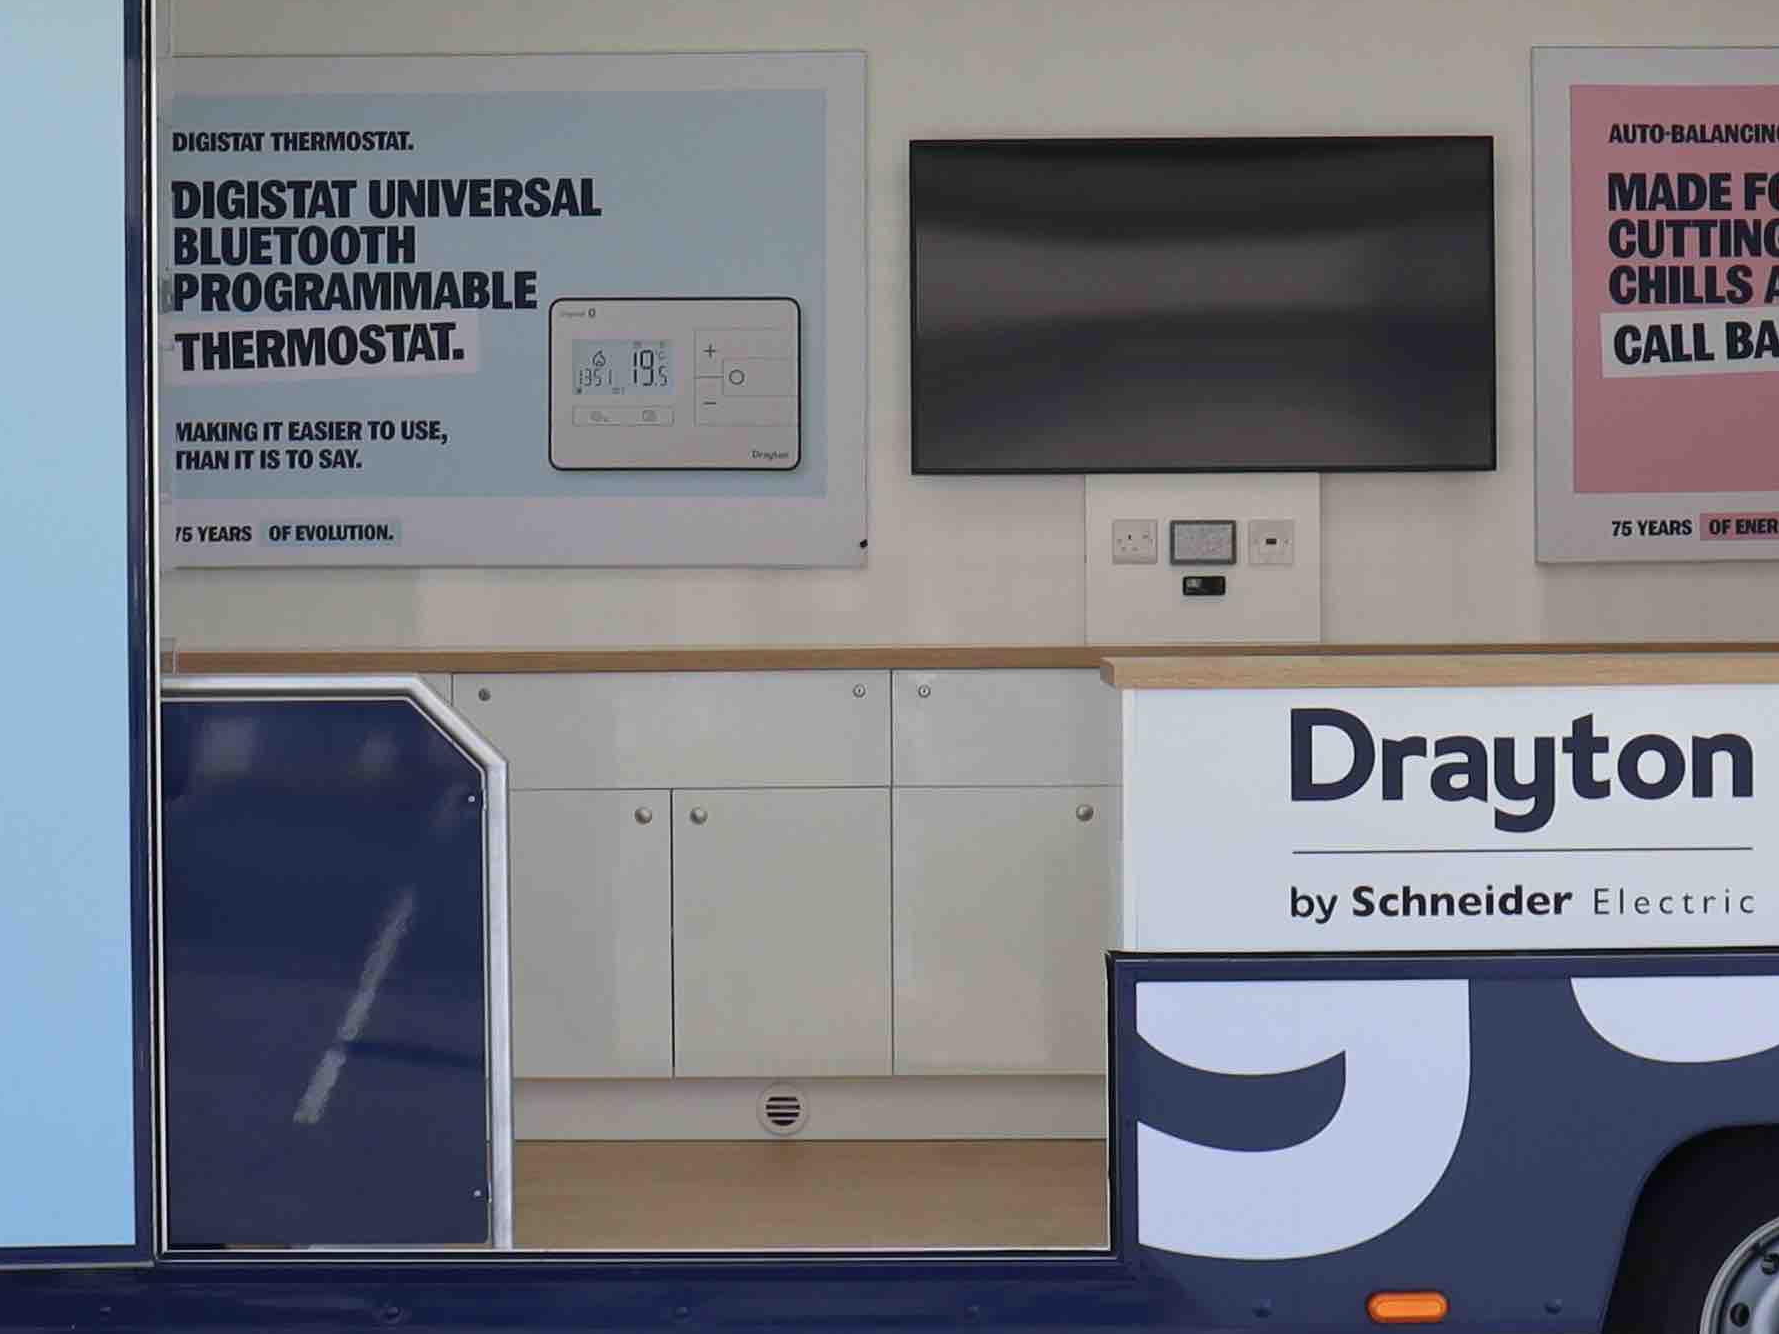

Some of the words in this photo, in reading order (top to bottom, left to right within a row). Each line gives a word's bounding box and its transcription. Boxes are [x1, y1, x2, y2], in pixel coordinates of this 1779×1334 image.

[173, 132, 264, 152] DIGISTAT
[270, 131, 414, 152] THERMOSTAT.
[171, 180, 356, 220] DIGISTAT
[368, 178, 601, 218] UNIVERSAL
[1608, 172, 1732, 211] MADE
[173, 226, 415, 266] BLUETOOTH
[173, 271, 538, 312] PROGRAMMABLE
[1609, 265, 1753, 304] CHILLS
[175, 322, 465, 371] THERMOSTAT.
[1614, 323, 1714, 365] CALL
[176, 422, 258, 442] MAKING
[263, 422, 283, 442] IT
[288, 421, 362, 441] EASIER
[367, 421, 395, 440] TO
[401, 420, 448, 445] USE,
[176, 450, 229, 470] THAN
[234, 450, 254, 469] IT
[260, 449, 280, 469] IS
[286, 449, 313, 469] TO
[319, 449, 363, 468] SAY.
[198, 526, 252, 542] YEARS
[269, 525, 292, 541] OF
[296, 524, 394, 541] EVOLUTION.
[1611, 521, 1631, 537] 75
[1638, 520, 1692, 536] YEARS
[1709, 519, 1732, 536] OF
[1290, 708, 1754, 834] Drayton
[1290, 887, 1338, 923] by
[1352, 884, 1573, 918] Schneider
[1593, 888, 1755, 916] Electric
